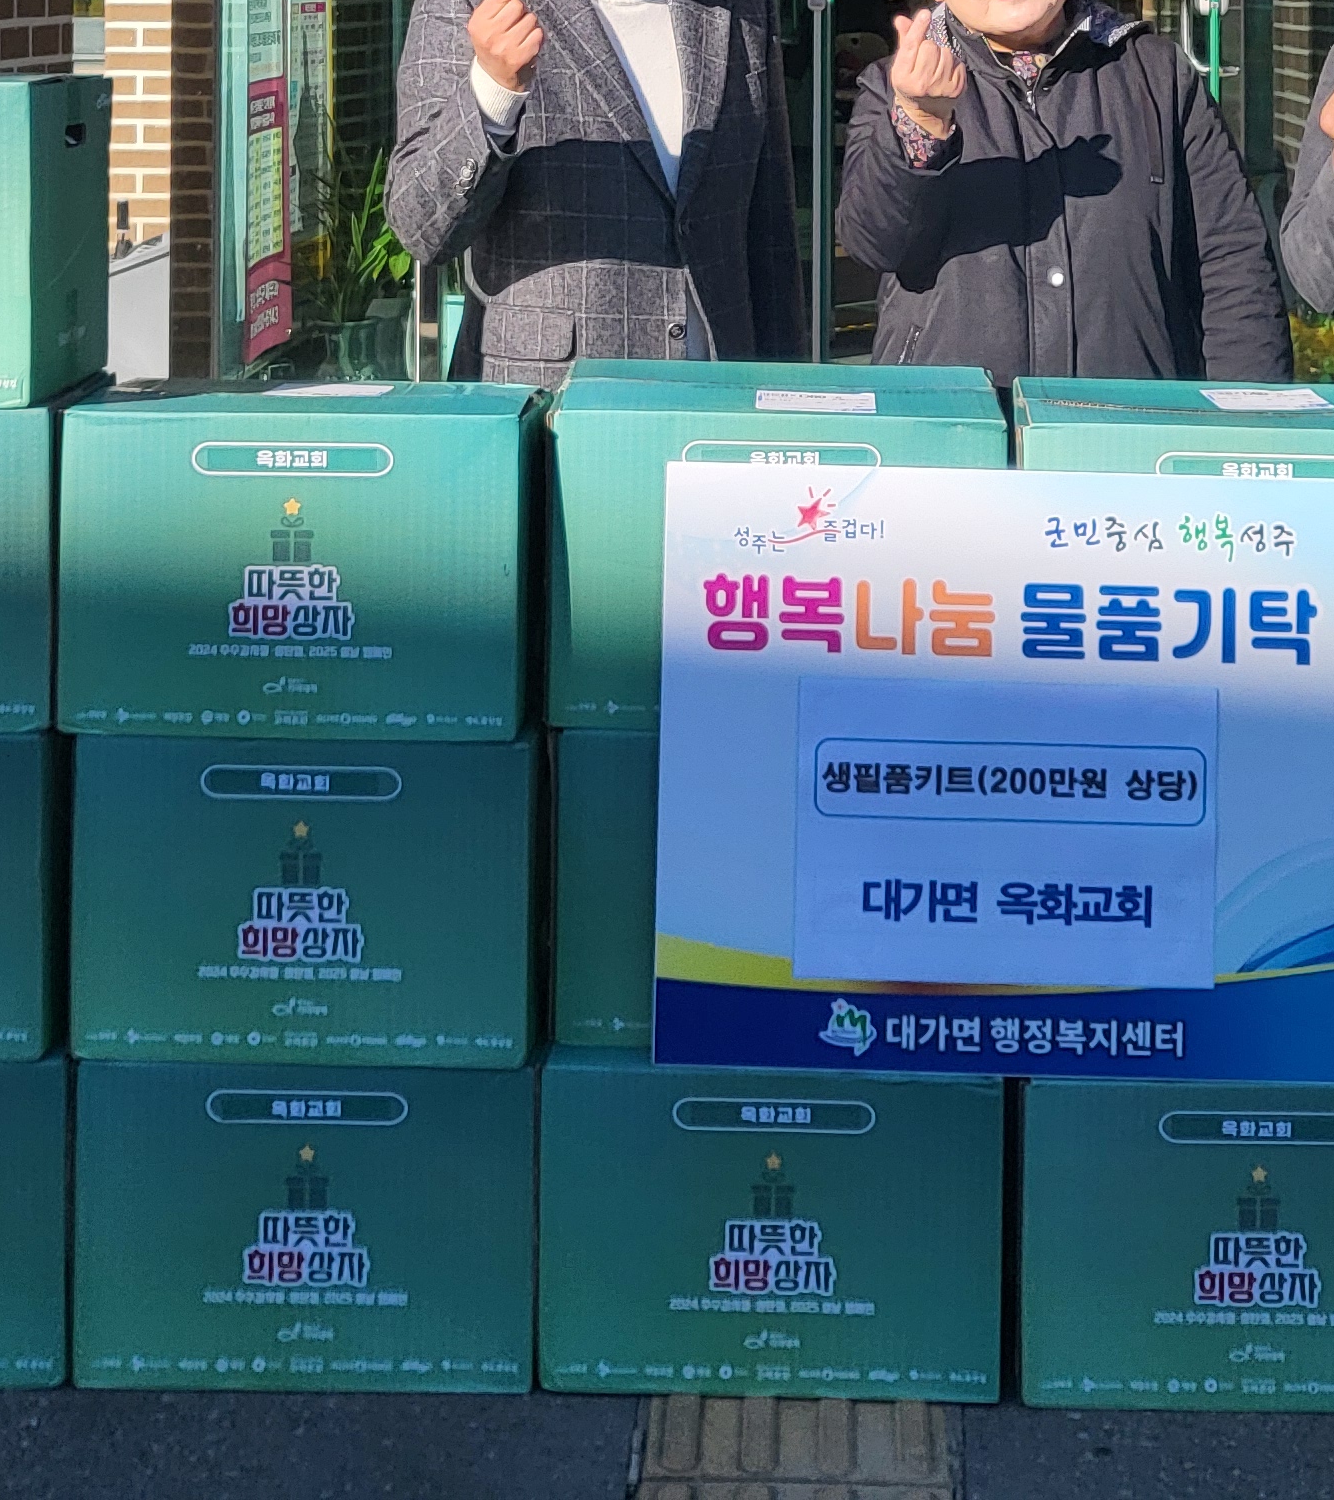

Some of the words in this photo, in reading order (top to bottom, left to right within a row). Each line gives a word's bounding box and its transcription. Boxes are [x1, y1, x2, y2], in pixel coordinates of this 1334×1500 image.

[256, 450, 328, 469] 옥화교회
[733, 526, 787, 553] 성주는
[823, 519, 885, 543] 즐겁다!
[1044, 515, 1164, 552] 군민중심
[1178, 513, 1296, 562] 행복성주
[247, 568, 339, 600] 따뜻한
[231, 602, 353, 637] 희망상자
[703, 572, 996, 658] 행복나눔
[1020, 582, 1319, 666] 물품기탁
[822, 761, 1107, 799] 생필품키트(200만원
[1125, 766, 1198, 802] 상당)
[256, 891, 348, 923] 따뜻한
[862, 879, 978, 923] 대가면
[996, 882, 1152, 928] 옥화교회
[240, 925, 363, 958] 희망상자
[885, 1015, 981, 1052] 대가면
[989, 1018, 1184, 1057] 행정복지센터
[262, 1215, 353, 1247] 따뜻한
[728, 1223, 820, 1256] 따뜻한
[1213, 1236, 1305, 1268] 따뜻한
[713, 1258, 835, 1292] 희망상자
[1198, 1271, 1319, 1305] 희망상자
